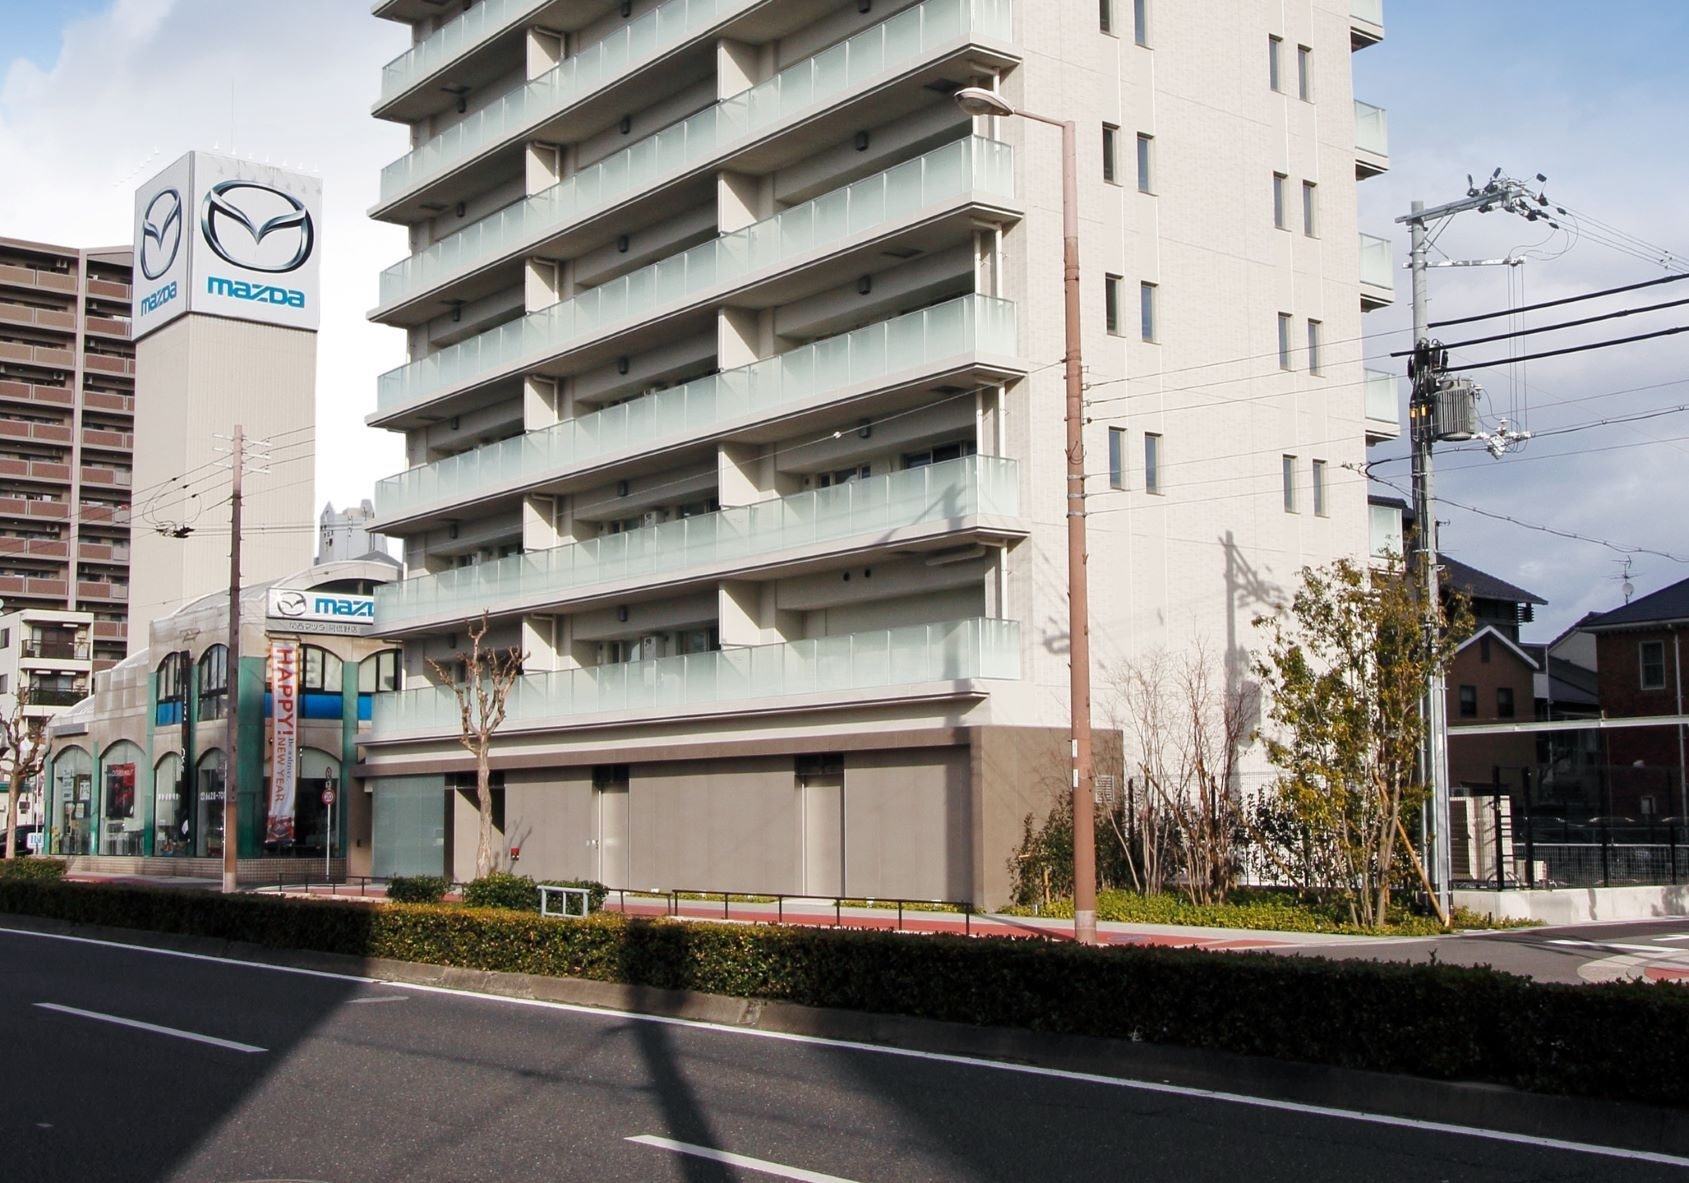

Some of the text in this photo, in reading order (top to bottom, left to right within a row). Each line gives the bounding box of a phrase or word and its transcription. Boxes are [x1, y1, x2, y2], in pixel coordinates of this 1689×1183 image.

[140, 280, 177, 316] mazda
[208, 276, 305, 309] mazda
[275, 648, 294, 802] HAPPY! NEW YEAR
